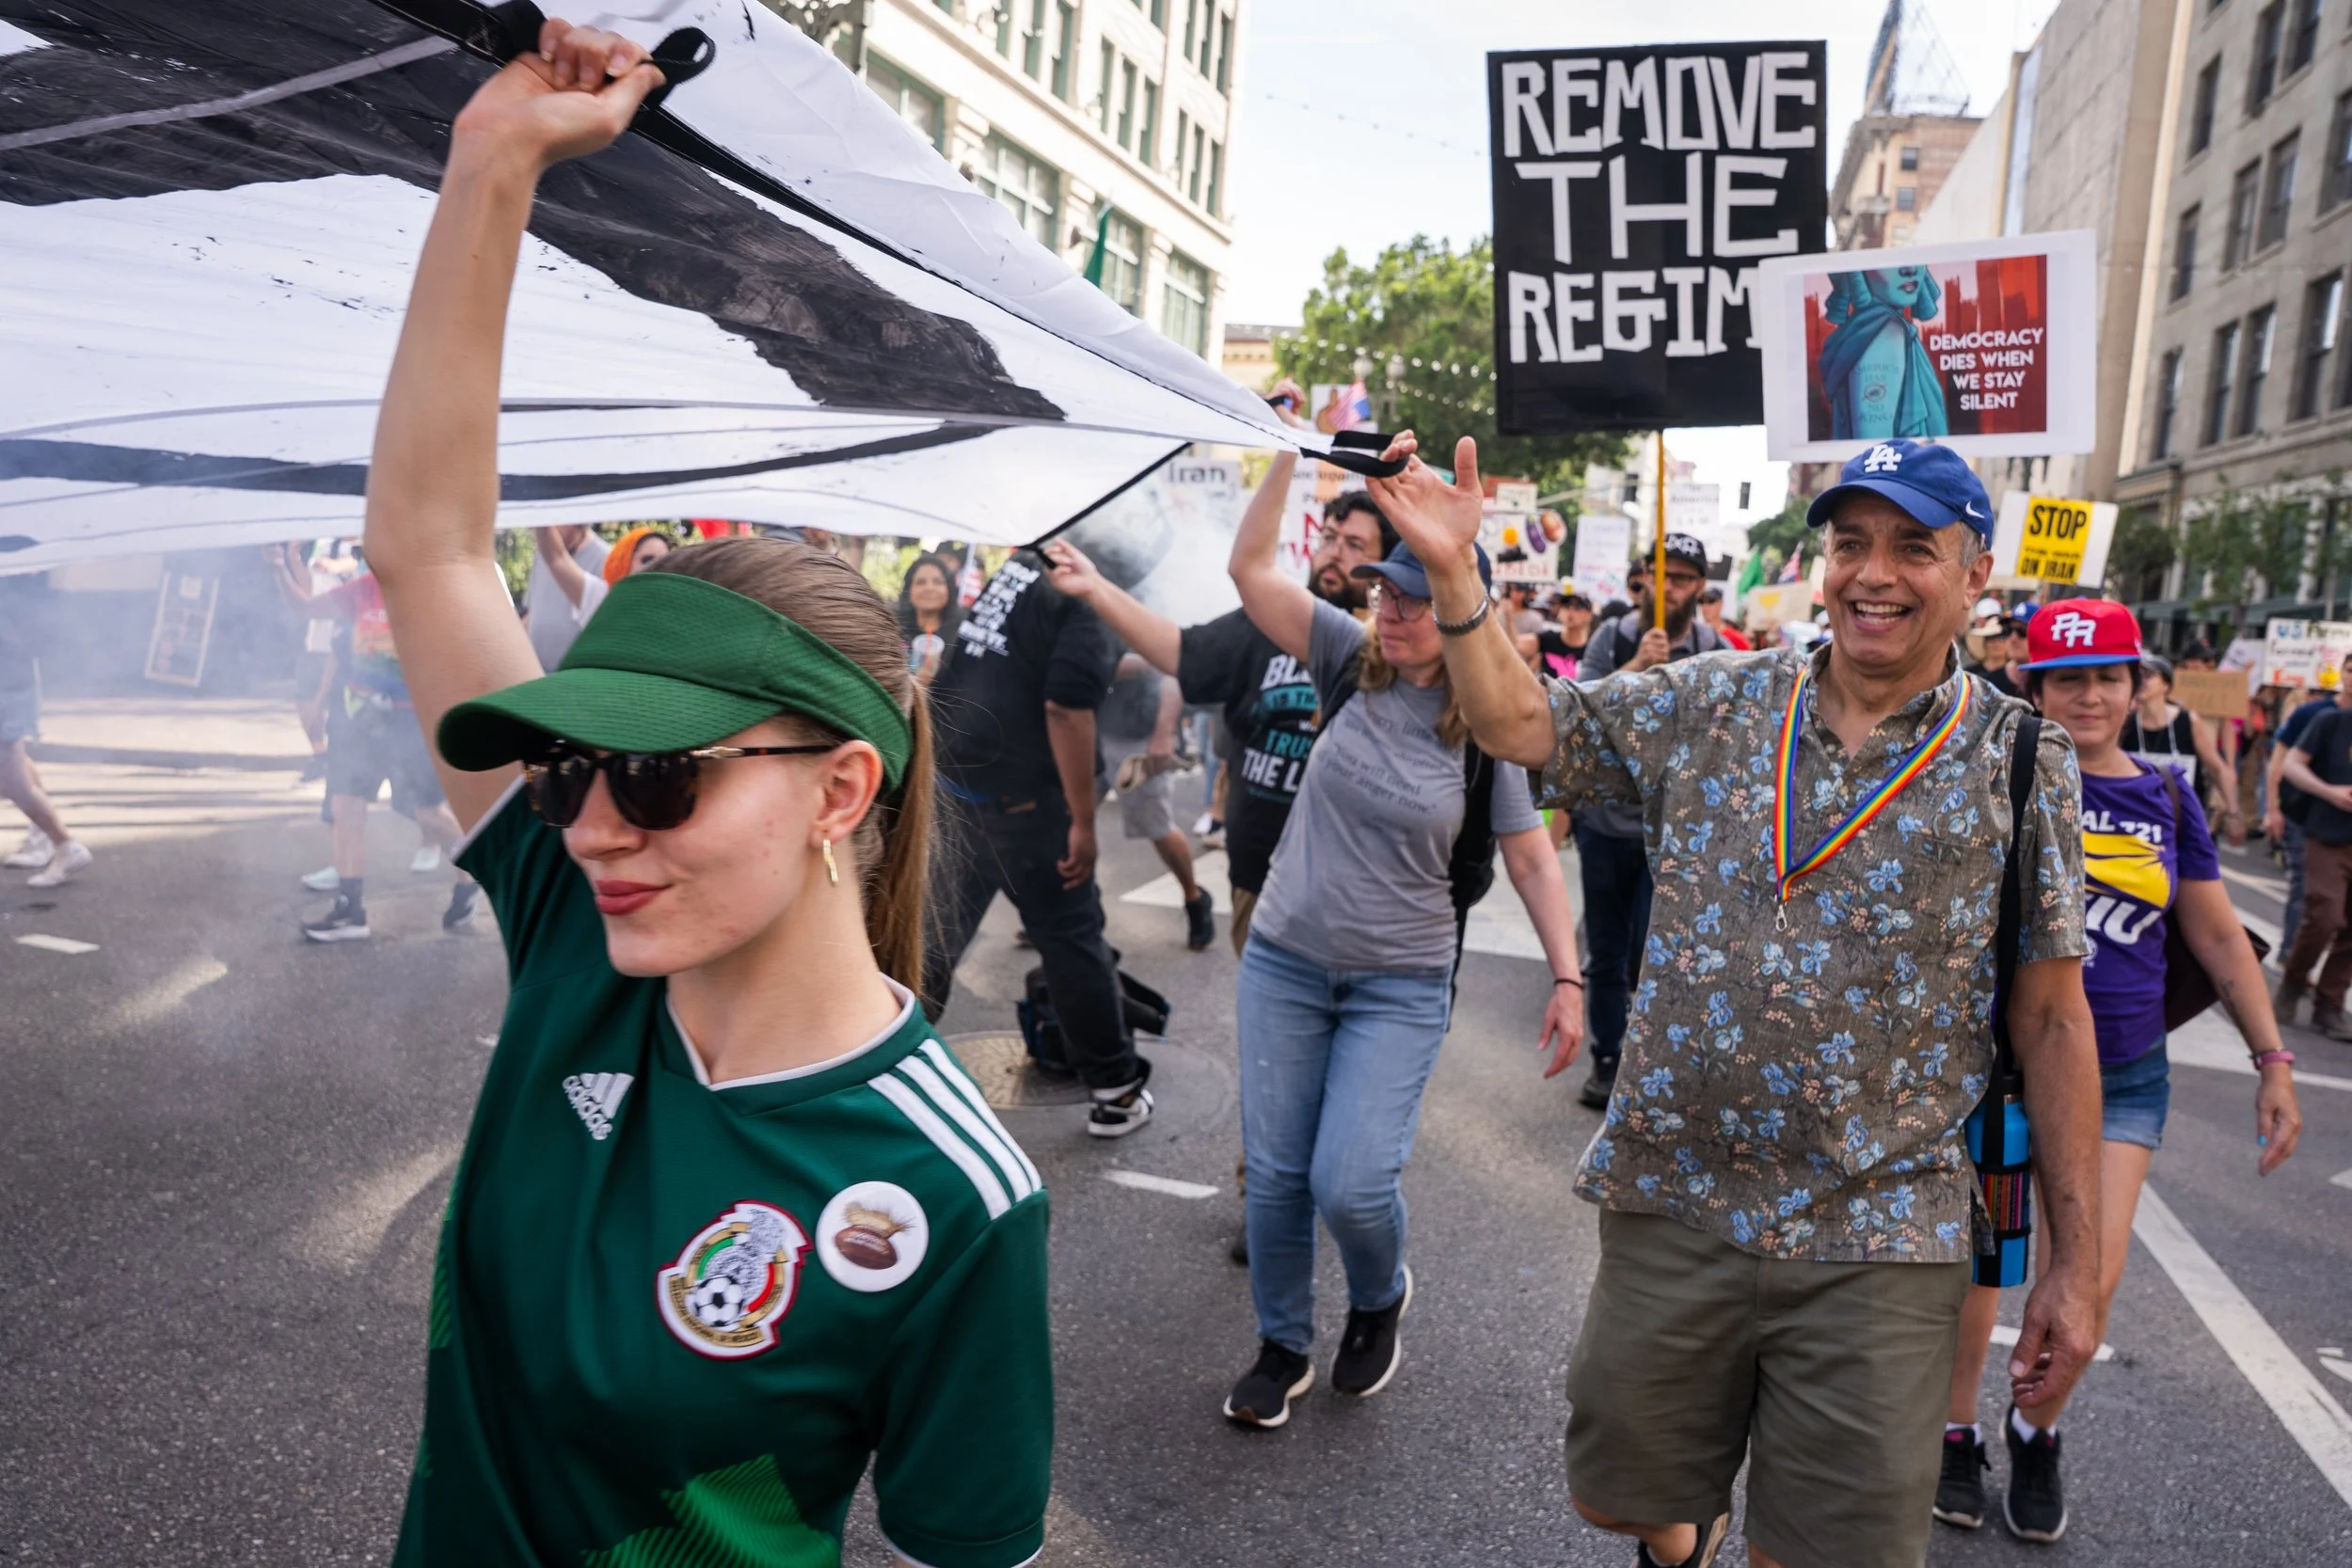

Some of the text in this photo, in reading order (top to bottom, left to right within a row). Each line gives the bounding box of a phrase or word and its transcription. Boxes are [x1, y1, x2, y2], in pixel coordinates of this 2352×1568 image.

[1502, 51, 1817, 158] REMOVE
[1515, 151, 1799, 265] THE
[1508, 265, 1762, 364] REGIM
[1930, 328, 2044, 351] DEMOCRACY
[1940, 349, 2034, 372] DIES WHEN
[1953, 371, 2026, 390] WE STAY
[1960, 391, 2019, 411] SILENT
[1168, 464, 1227, 483] Iran
[1864, 444, 1902, 473] LA
[2029, 504, 2087, 540] STOP
[2021, 557, 2076, 579] ON IRAN
[2050, 611, 2097, 648] PR
[1265, 730, 1313, 760] TRUS
[1242, 747, 1285, 788] THE
[1283, 761, 1300, 793] L
[562, 1075, 613, 1141] adidas
